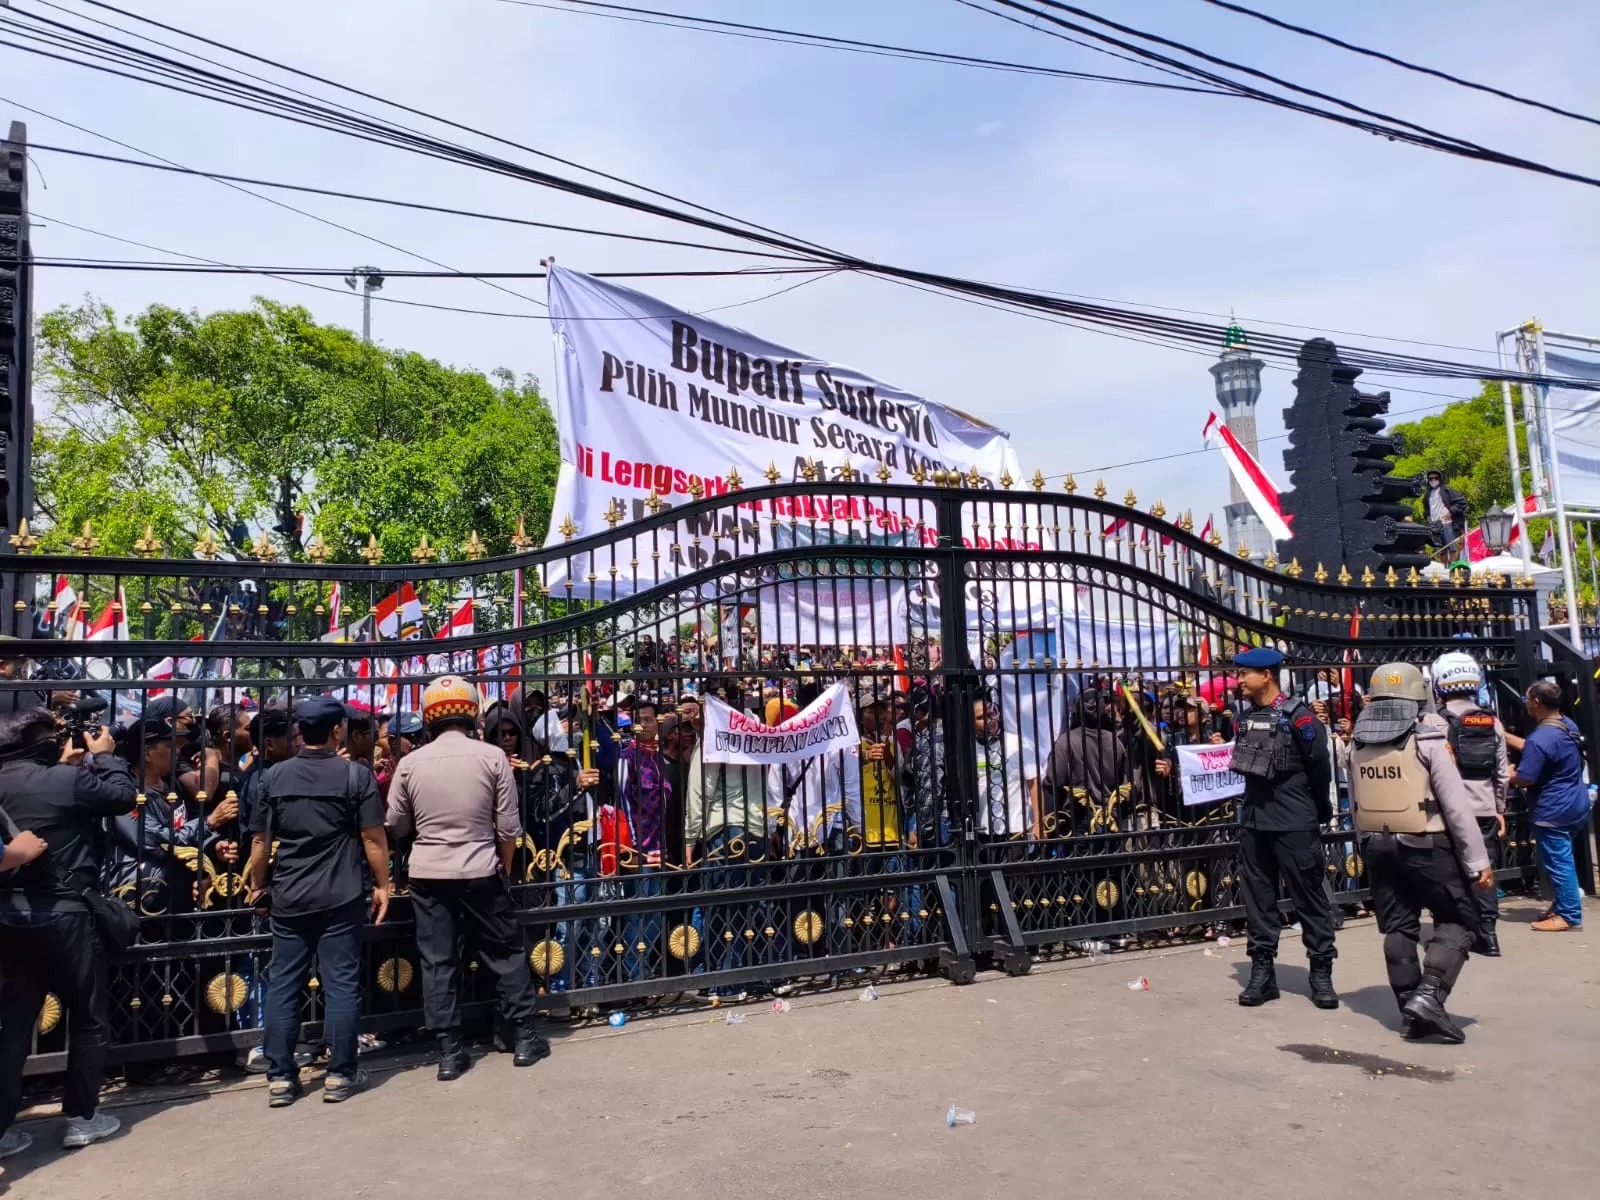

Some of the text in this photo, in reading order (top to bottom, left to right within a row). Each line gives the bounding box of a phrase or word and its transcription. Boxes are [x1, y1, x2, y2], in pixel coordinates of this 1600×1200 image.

[670, 319, 805, 405] Bupati
[600, 350, 679, 412] Pilih
[687, 382, 801, 445] Mundur
[810, 416, 898, 470] Secara
[601, 451, 763, 512] Lengserk
[1447, 666, 1480, 677] POLIS
[1360, 765, 1402, 780] POLISI
